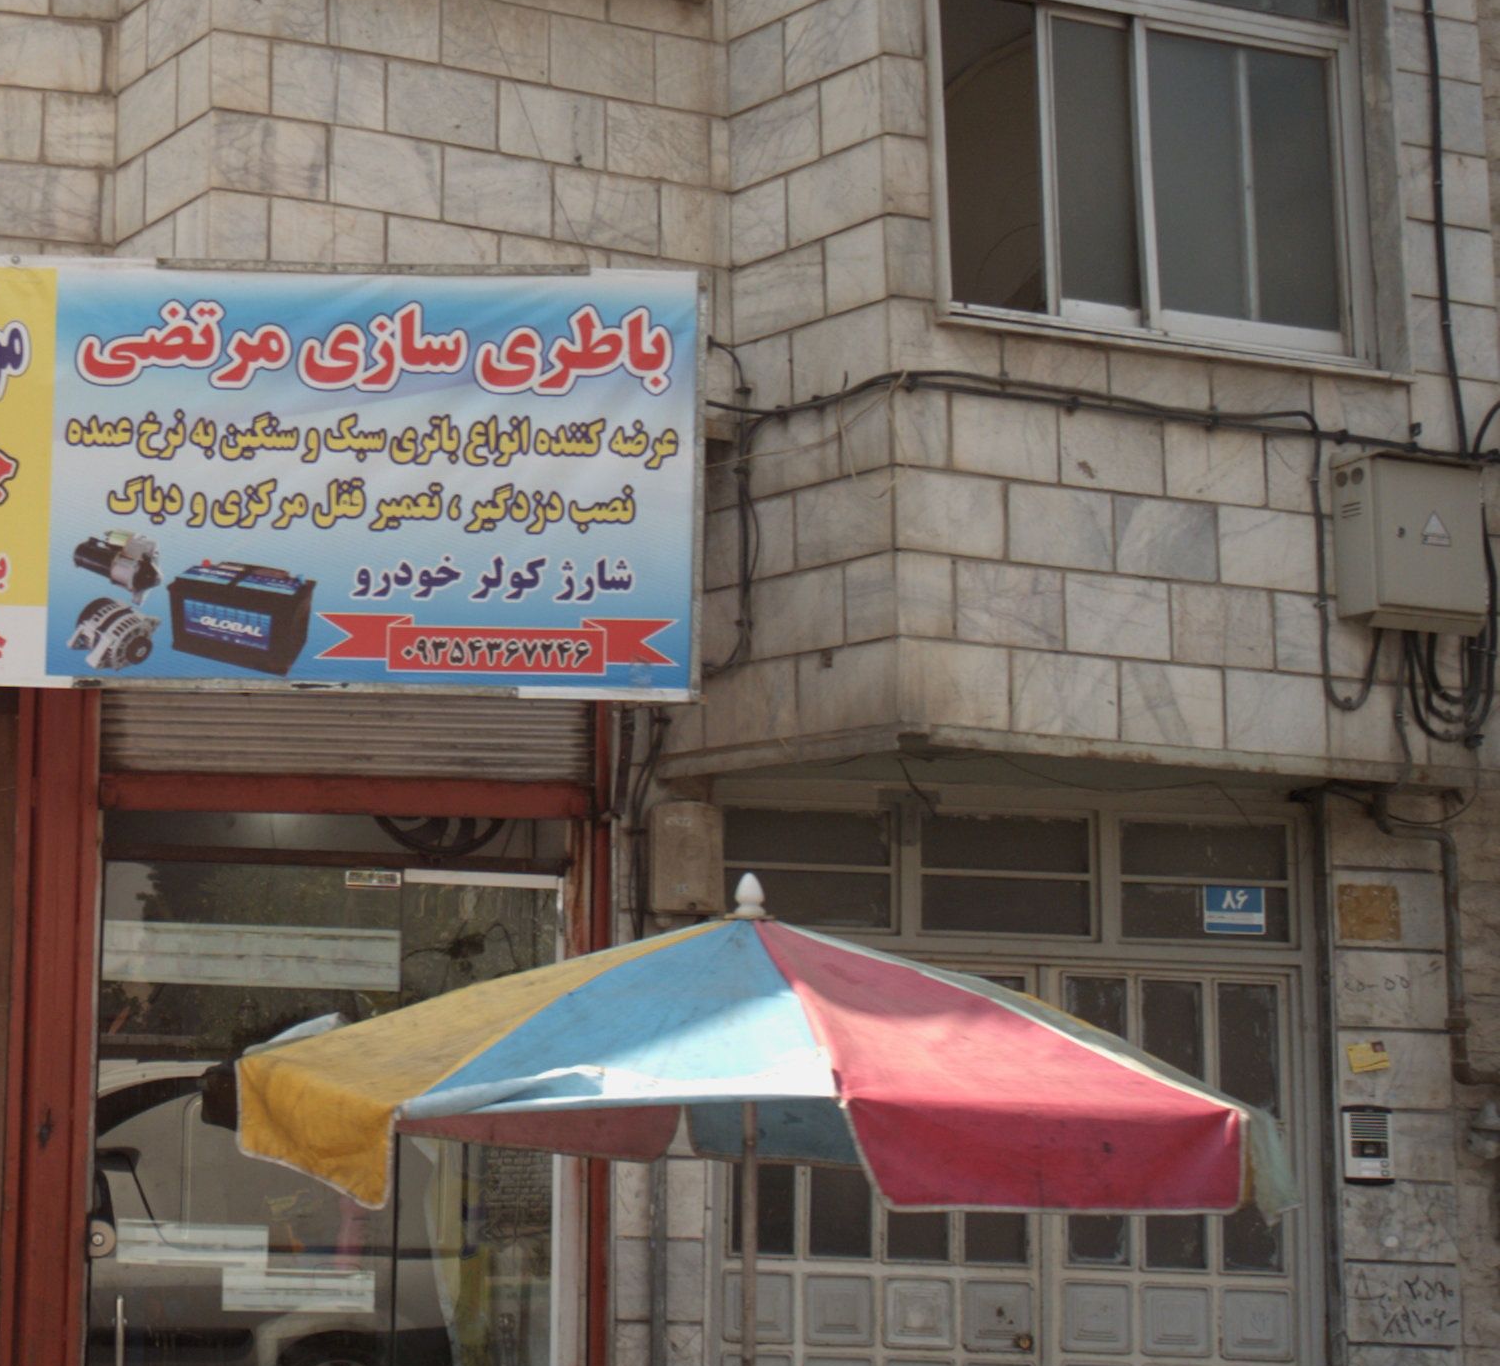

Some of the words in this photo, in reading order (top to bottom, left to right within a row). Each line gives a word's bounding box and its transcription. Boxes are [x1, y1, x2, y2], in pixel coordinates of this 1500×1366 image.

[81, 301, 289, 387] مرتضی
[302, 303, 466, 390] سازی
[479, 307, 670, 393] باطری
[65, 414, 134, 447] عمده
[135, 408, 187, 460] نرخ
[189, 417, 217, 460] به
[219, 411, 300, 461] سنگین
[300, 426, 321, 463] و
[324, 412, 387, 463] سبک
[389, 413, 461, 466] باتری
[463, 414, 531, 467] انواع
[533, 418, 606, 457] کننده
[608, 419, 679, 469] عرضه
[106, 474, 184, 525] دیاگ
[186, 490, 207, 528] و
[211, 477, 309, 530] مرکزی
[311, 477, 367, 529] قفل
[368, 481, 444, 532] تعمیر
[568, 483, 636, 534] نصب
[350, 553, 463, 599] خودرو
[468, 554, 548, 601] کولر
[553, 557, 633, 602] شارژ
[199, 615, 263, 637] GLOBAL
[401, 636, 591, 668] ۰۹۳۵۴۳۶۷۲۴۶
[1220, 889, 1249, 910] ۸۶
